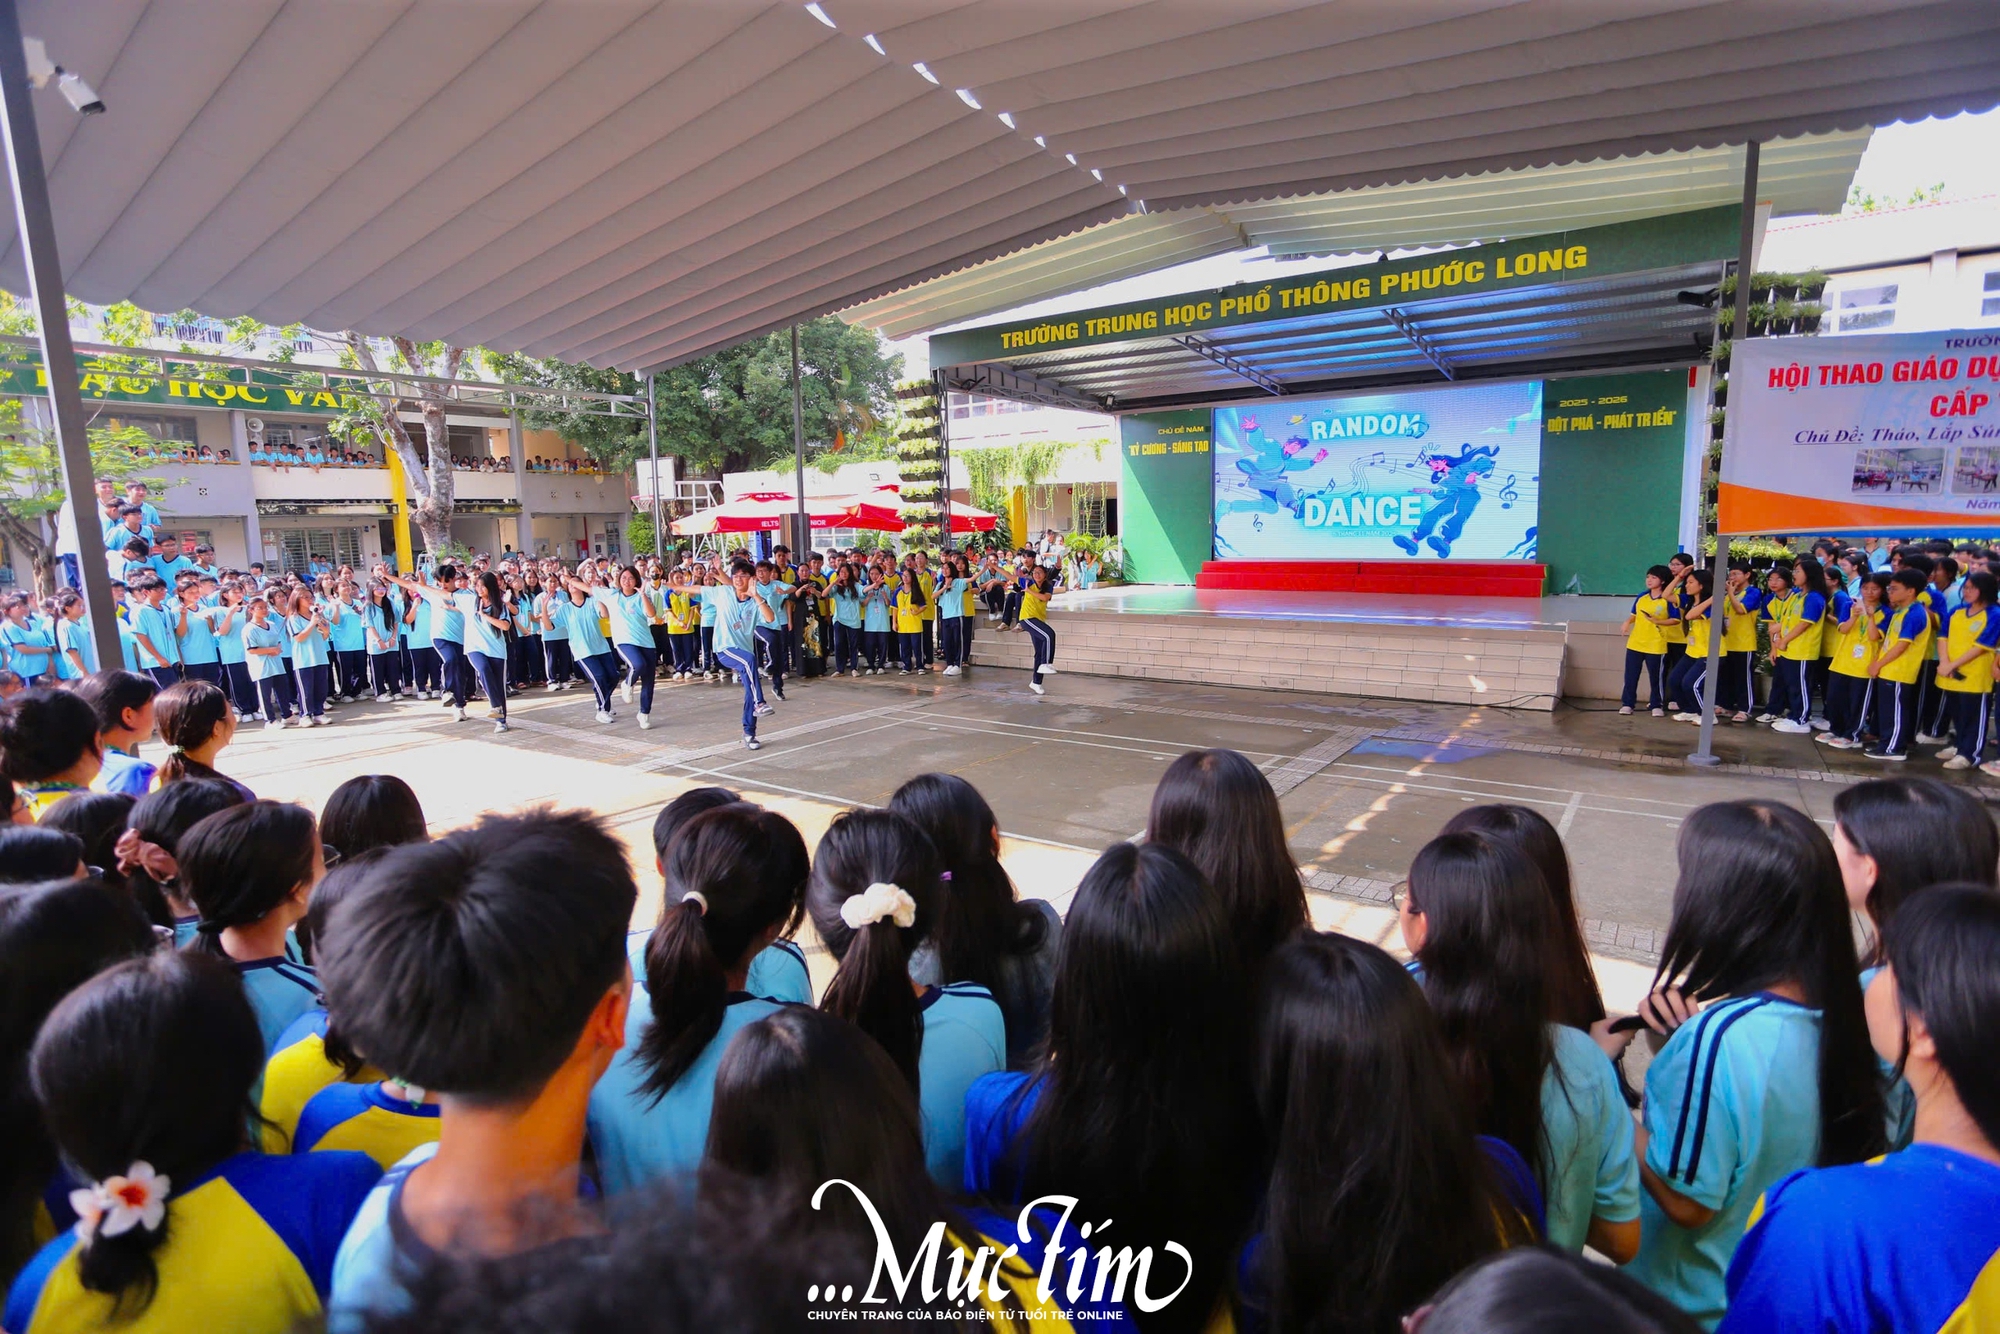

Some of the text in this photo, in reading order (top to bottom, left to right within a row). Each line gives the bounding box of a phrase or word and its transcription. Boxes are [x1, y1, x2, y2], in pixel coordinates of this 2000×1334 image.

[1001, 245, 1588, 349] TRƯỜNG TRUNG HỌC PHỔ THÔNG PHƯỚC LONG
[1768, 362, 1810, 392] HỘI
[1818, 362, 1884, 386] THAO
[1892, 355, 1959, 382] GIÁO
[1560, 399, 1588, 408] 2025
[1598, 396, 1628, 405] 2026
[1930, 386, 1989, 418] CẤP
[1311, 414, 1421, 441] RANDOM
[1547, 416, 1568, 435] ĐỘT
[1571, 414, 1594, 432] PHÁ
[1604, 411, 1634, 430] PHÁT
[1872, 428, 1920, 442] Tháo,
[1927, 422, 1962, 443] Lắp
[1172, 440, 1193, 454] SÁNG
[1194, 440, 1209, 455] TẠO
[1304, 496, 1422, 527] DANCE
